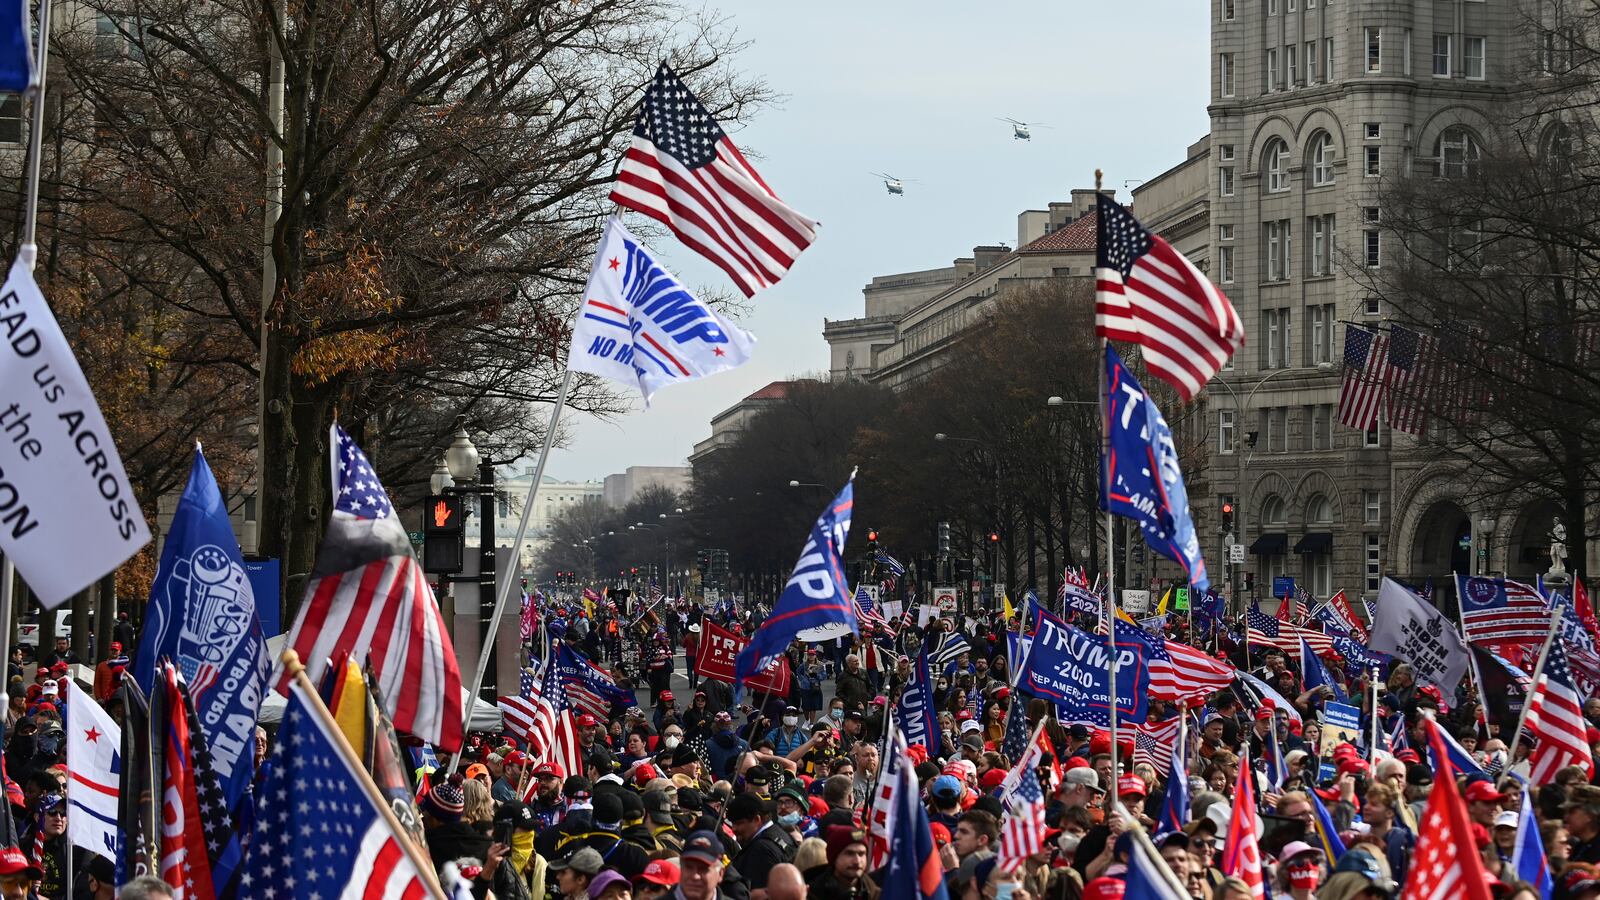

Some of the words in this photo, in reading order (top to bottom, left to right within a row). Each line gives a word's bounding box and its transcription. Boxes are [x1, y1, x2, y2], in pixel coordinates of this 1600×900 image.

[622, 239, 729, 344] TRUMP
[588, 335, 617, 358] NO
[0, 402, 42, 461] the
[33, 364, 65, 404] us
[58, 409, 137, 541] ACROSS
[0, 466, 39, 540] ON
[1043, 619, 1135, 674] TRUMP
[1333, 635, 1381, 667] TRUMP
[1408, 634, 1424, 652] YOU
[1422, 651, 1448, 674] LIKE
[1409, 617, 1449, 660] BIDEN
[903, 661, 927, 749] RUMP
[1092, 693, 1132, 706] GRAT!
